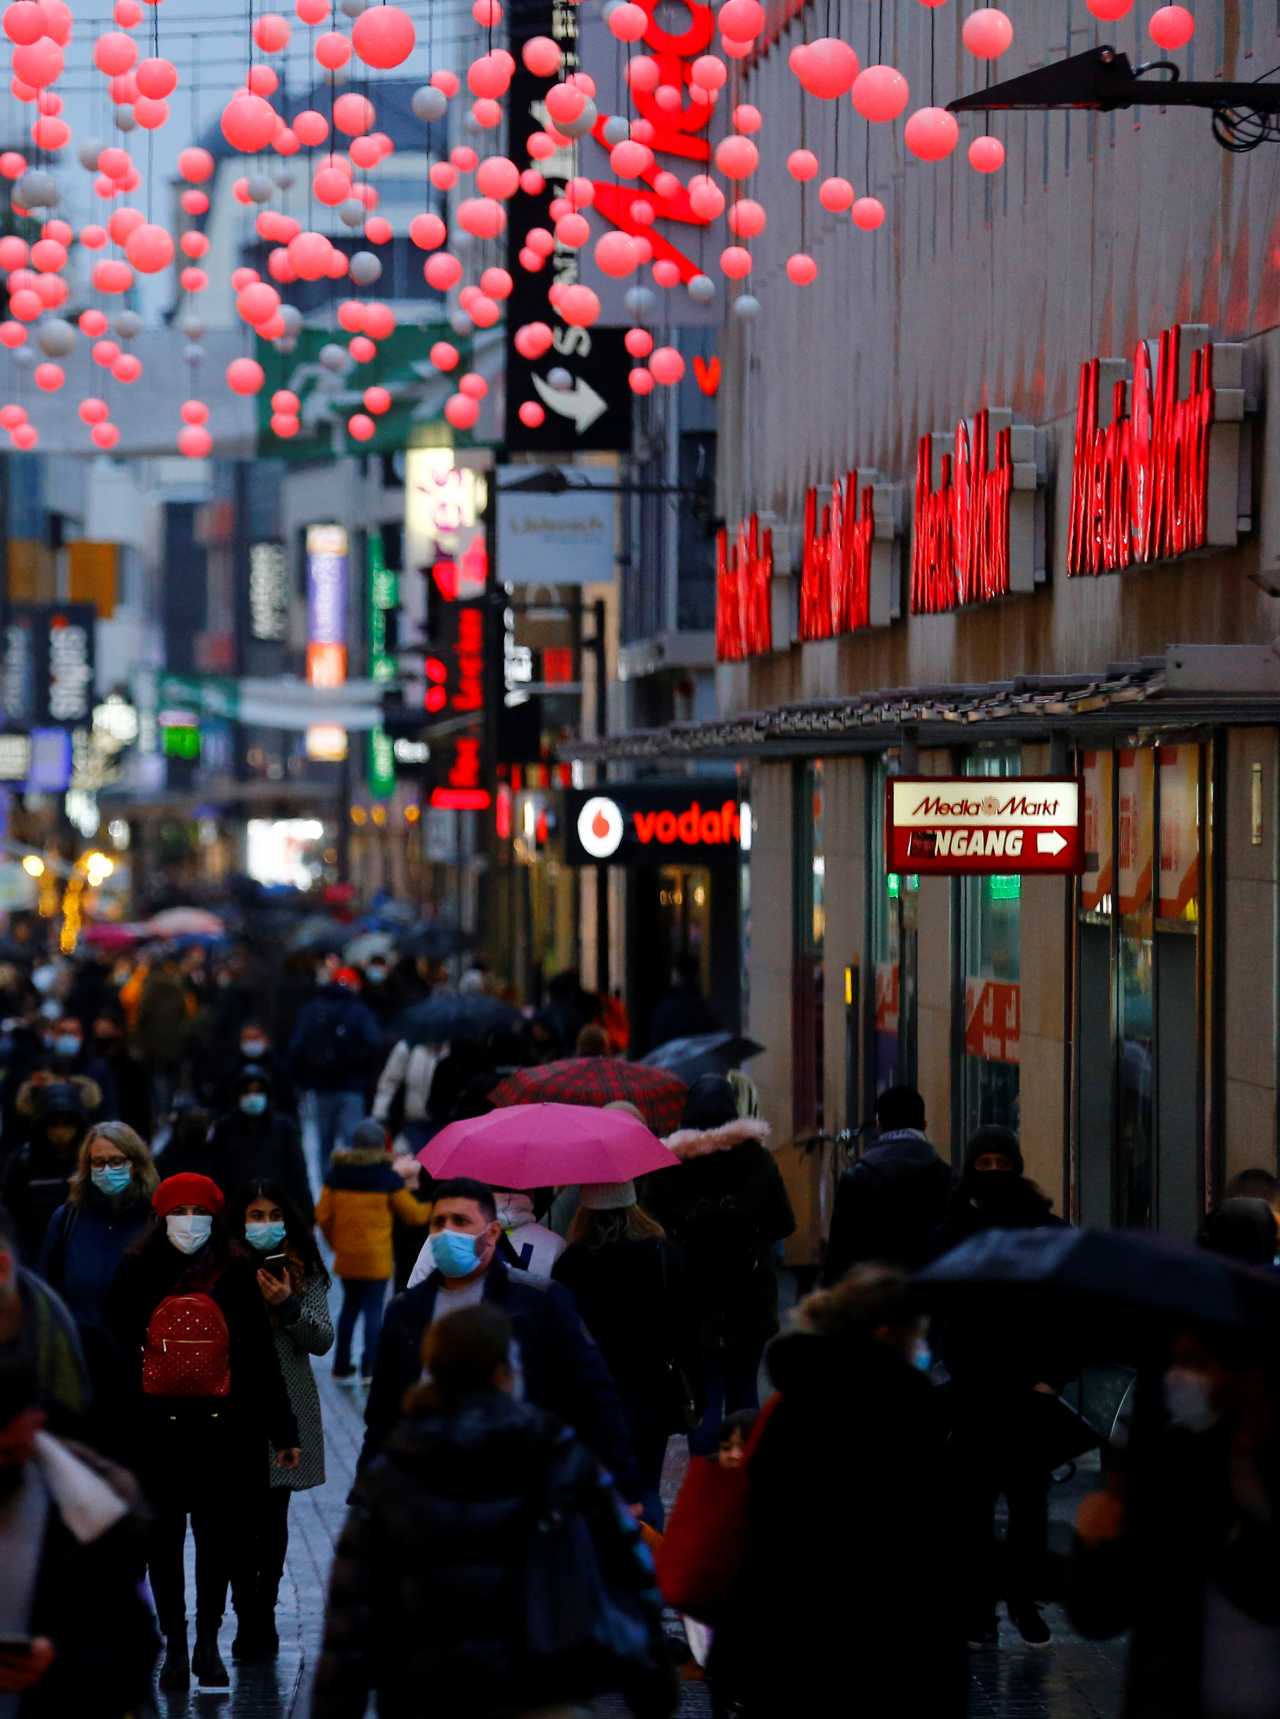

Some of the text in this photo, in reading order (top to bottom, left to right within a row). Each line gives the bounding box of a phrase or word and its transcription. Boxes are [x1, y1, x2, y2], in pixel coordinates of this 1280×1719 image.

[912, 795, 1060, 816] Media Markt
[907, 829, 1025, 857] NGANG
